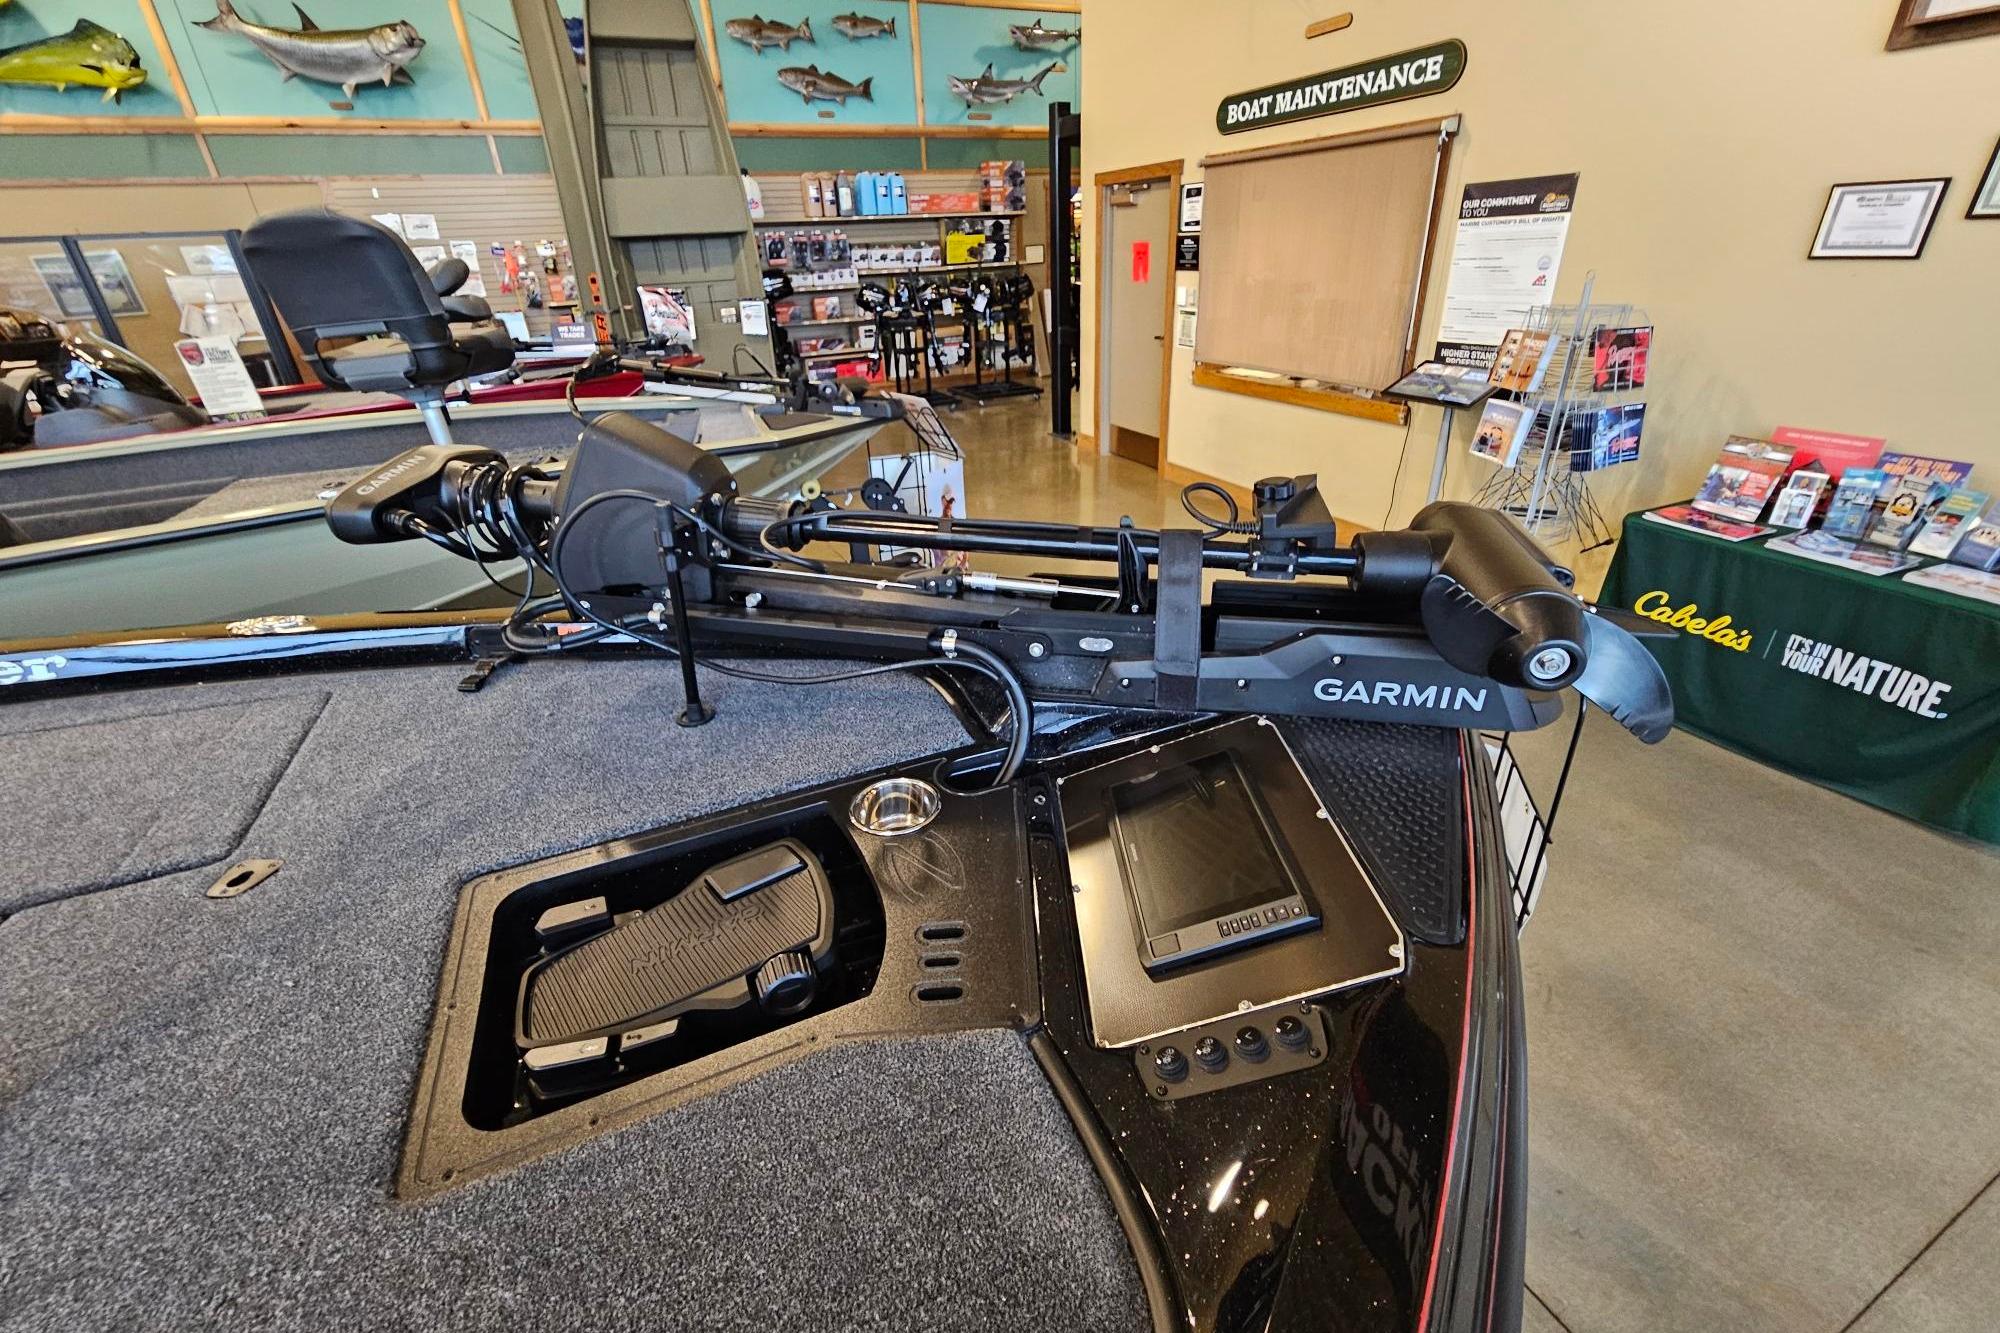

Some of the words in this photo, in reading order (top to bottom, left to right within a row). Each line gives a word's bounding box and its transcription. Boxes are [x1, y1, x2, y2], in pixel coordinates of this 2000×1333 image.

[1226, 95, 1272, 124] BOAT
[1274, 54, 1444, 114] MAINTENANCE
[1462, 199, 1480, 209] OUR
[1481, 194, 1537, 207] COMMITMENT
[1462, 209, 1472, 217] TO
[1472, 208, 1489, 217] YOU
[1440, 347, 1470, 359] HIGHER
[355, 454, 427, 496] GARMIN
[1634, 590, 1753, 653] Cabela's
[1786, 633, 1814, 655] IT'S
[1812, 641, 1832, 660] IN
[1781, 647, 1825, 677] YOUR
[1313, 677, 1488, 712] GARMIN
